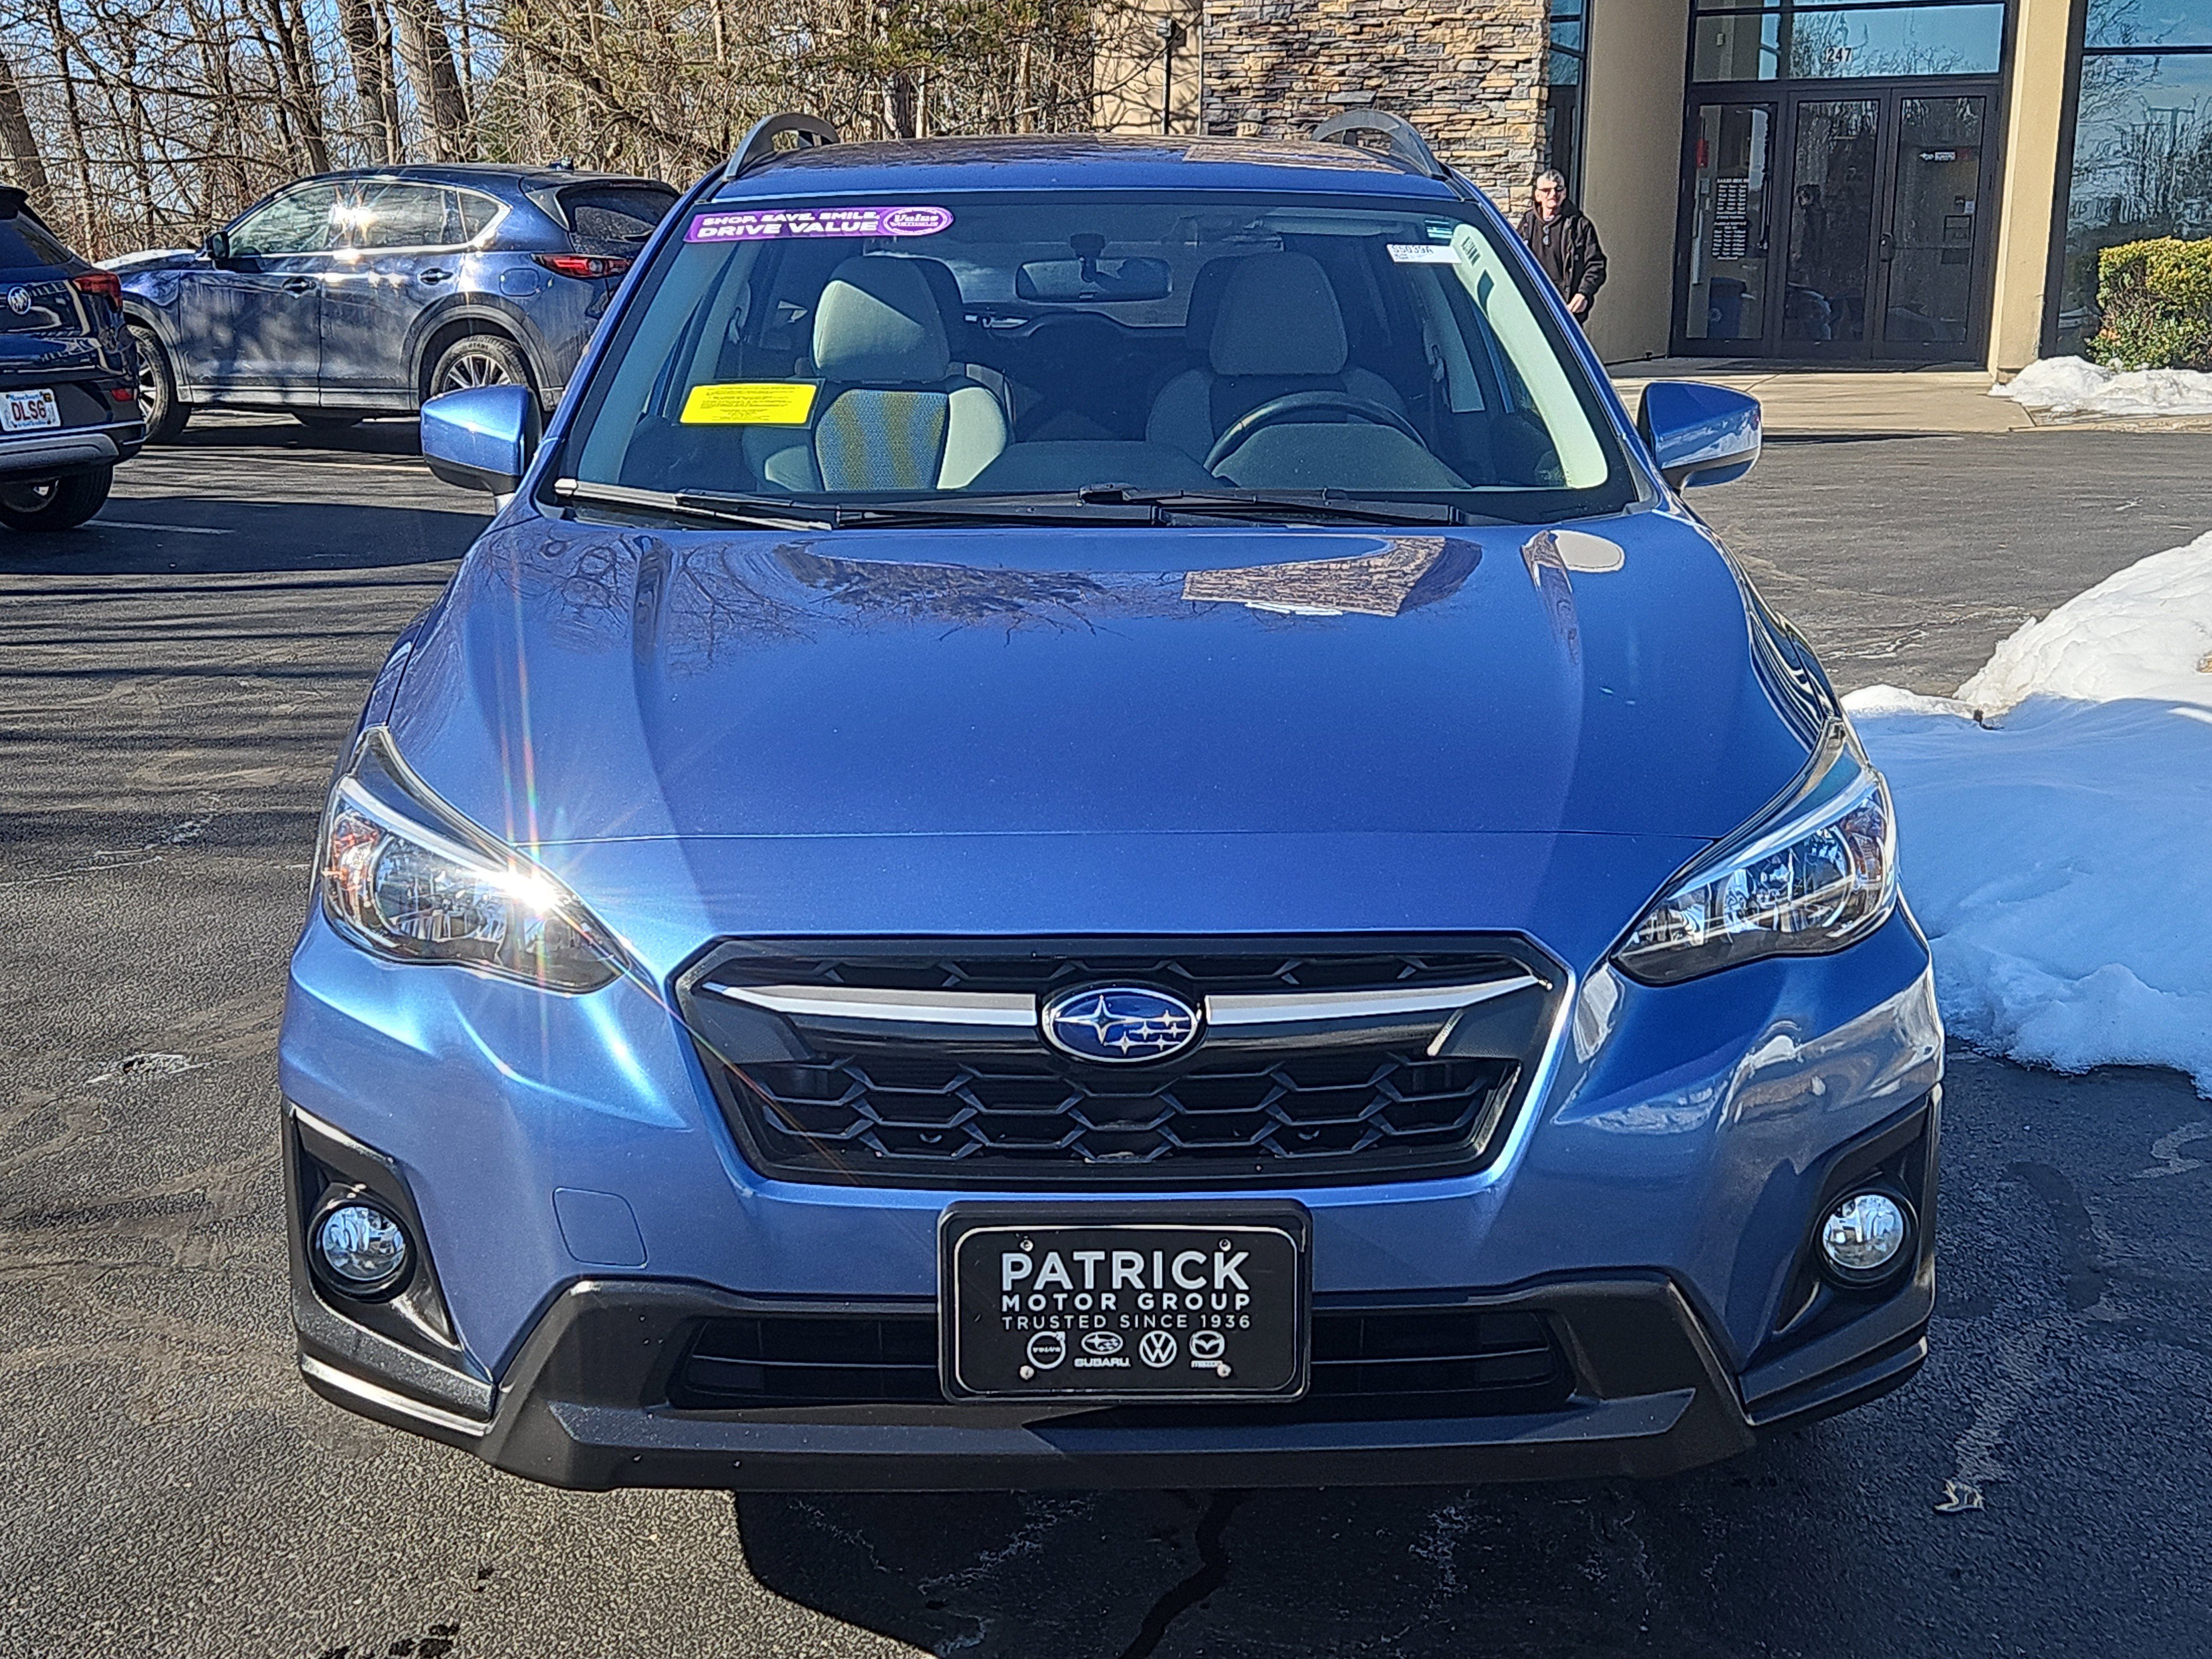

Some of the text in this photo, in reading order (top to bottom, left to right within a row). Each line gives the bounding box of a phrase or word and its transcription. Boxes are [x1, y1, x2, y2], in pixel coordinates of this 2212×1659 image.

[1827, 47, 1852, 62] 247
[697, 221, 878, 237] DRIVE VALUE
[11, 400, 47, 421] DLS6
[1002, 1251, 1249, 1291] PATRICK
[1002, 1293, 1250, 1312] MOTOR GROUP
[1002, 1314, 1250, 1330] TRUSTED SINCE 1936
[1073, 1357, 1130, 1367] SUBARU
